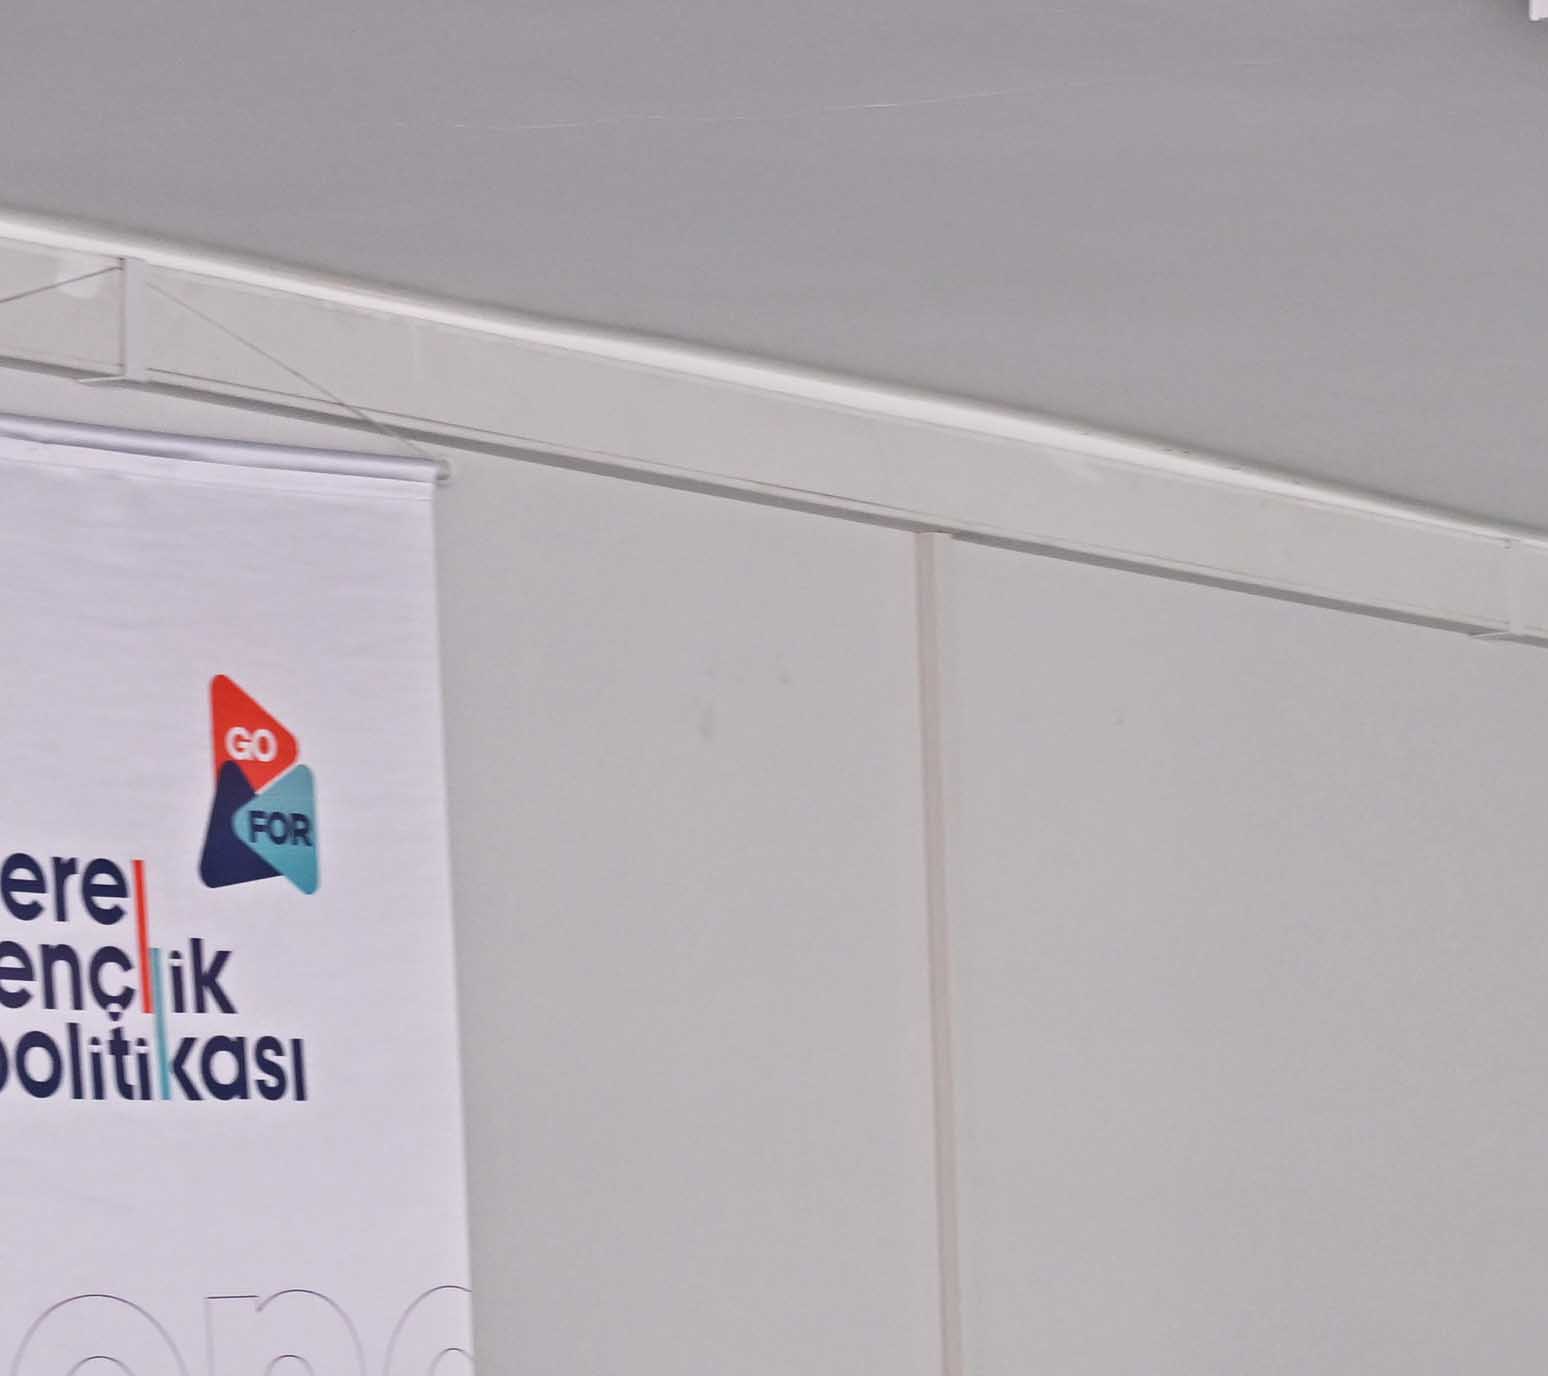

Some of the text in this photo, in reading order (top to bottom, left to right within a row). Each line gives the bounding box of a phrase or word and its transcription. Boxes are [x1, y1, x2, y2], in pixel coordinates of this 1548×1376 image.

[224, 726, 277, 762] GO
[248, 810, 313, 846] FOR
[0, 1022, 308, 1101] olitikası
